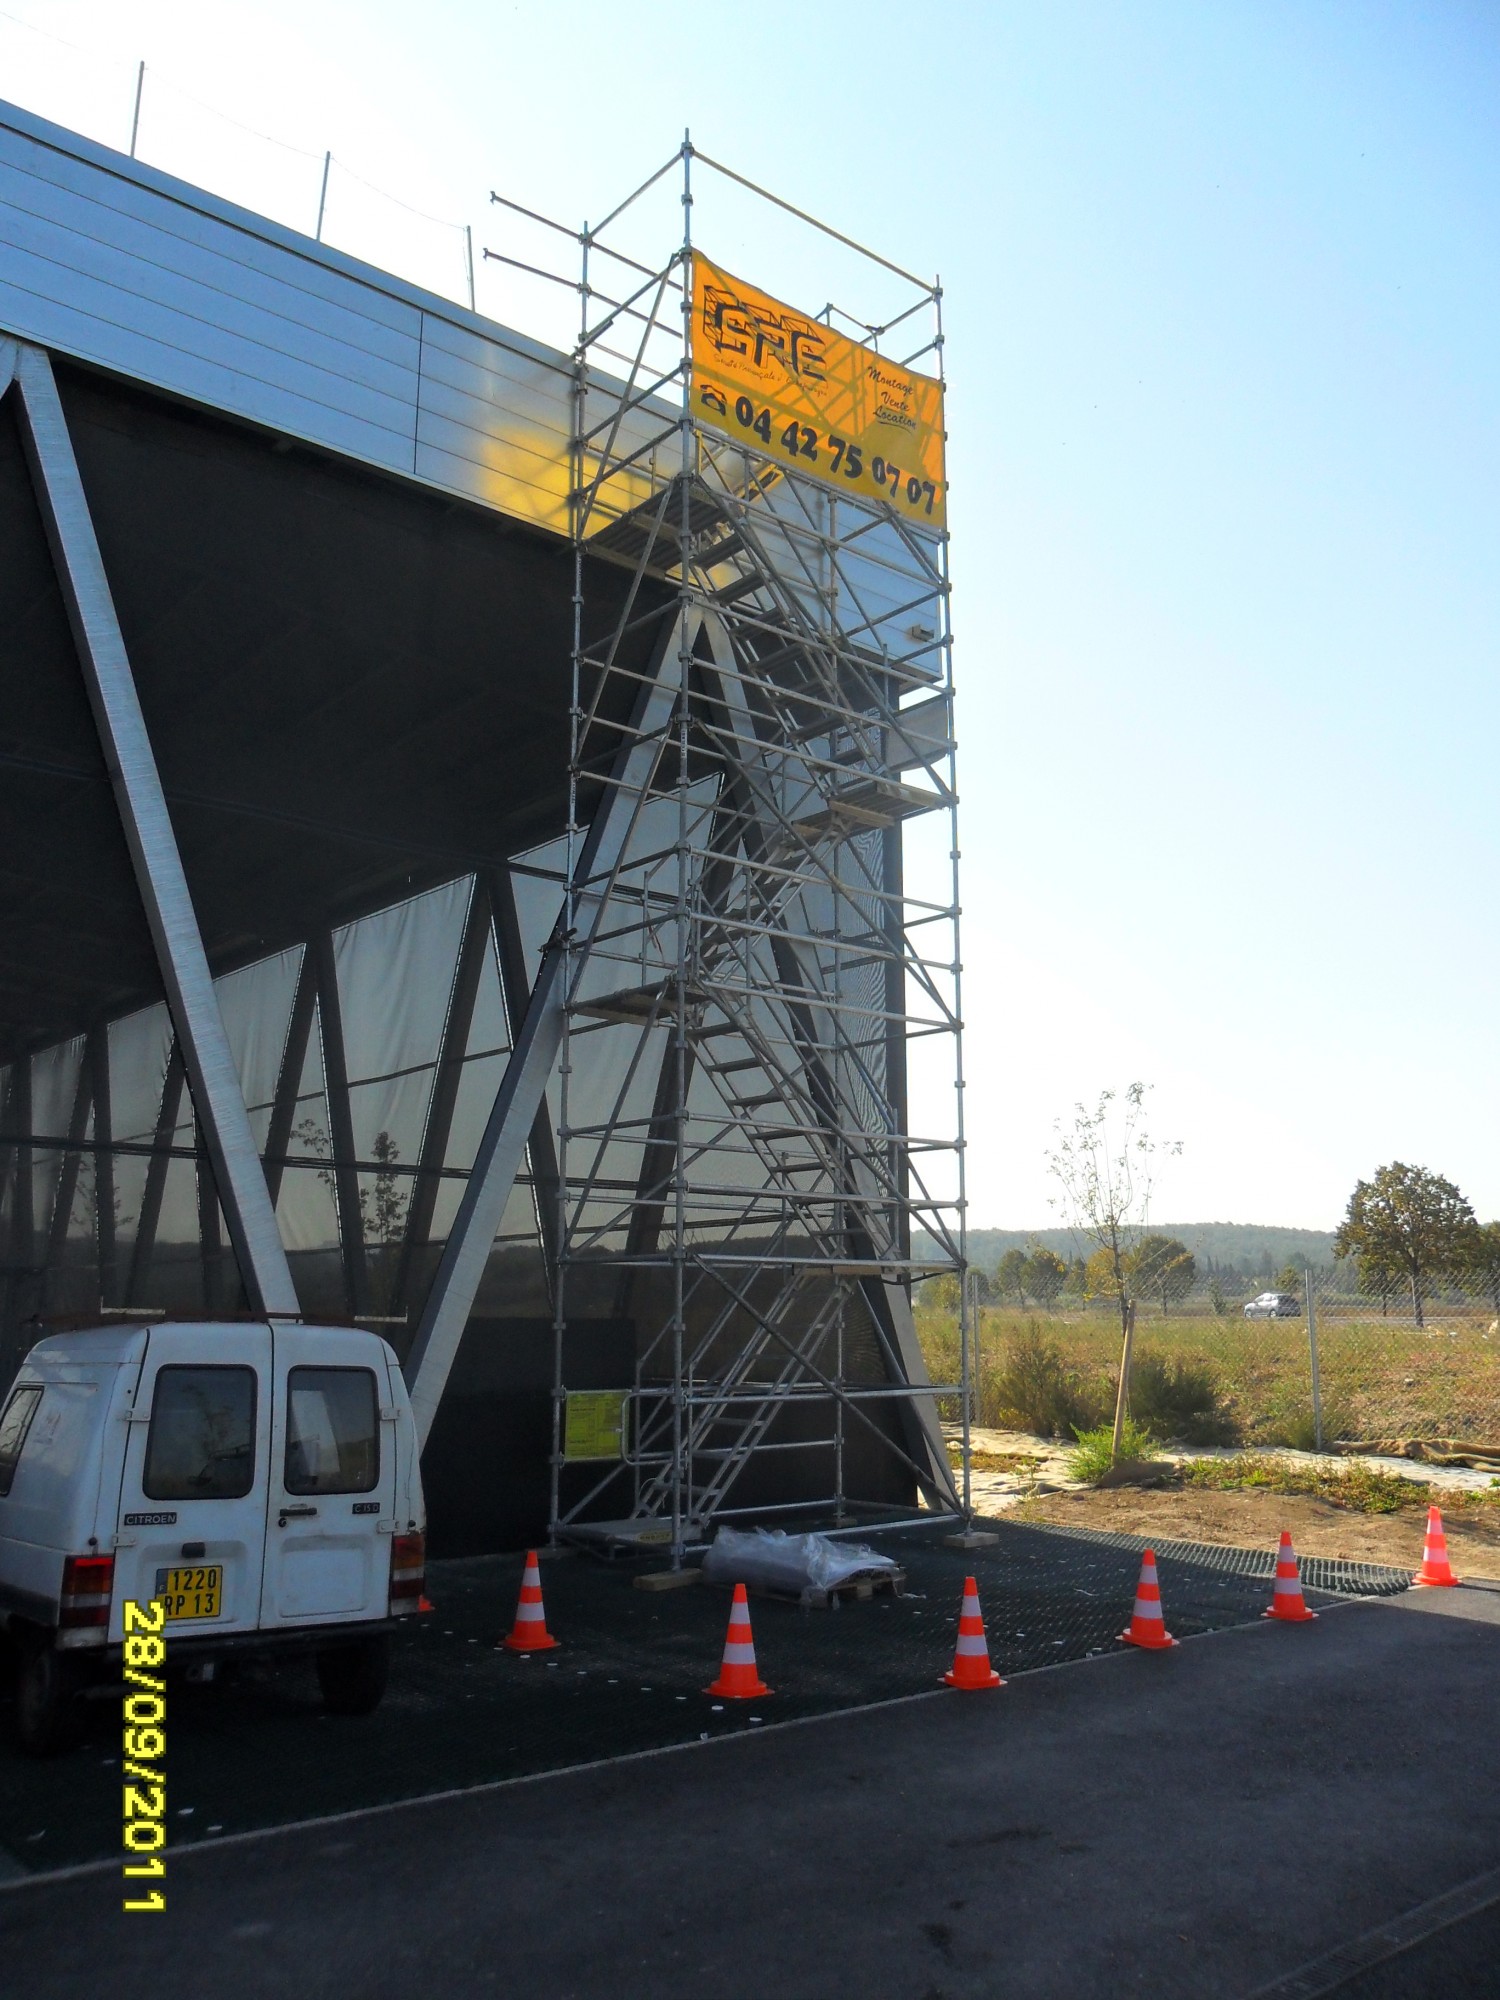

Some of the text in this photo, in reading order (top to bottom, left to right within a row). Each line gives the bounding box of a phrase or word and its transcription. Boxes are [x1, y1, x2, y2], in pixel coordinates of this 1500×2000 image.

[868, 366, 913, 397] Montage
[881, 391, 910, 412] Vente
[873, 405, 916, 430] Location
[735, 396, 936, 515] 04 42 75 07 07
[126, 1514, 176, 1525] CITROEN
[173, 1569, 217, 1591] 1220
[164, 1593, 214, 1615] RP 13
